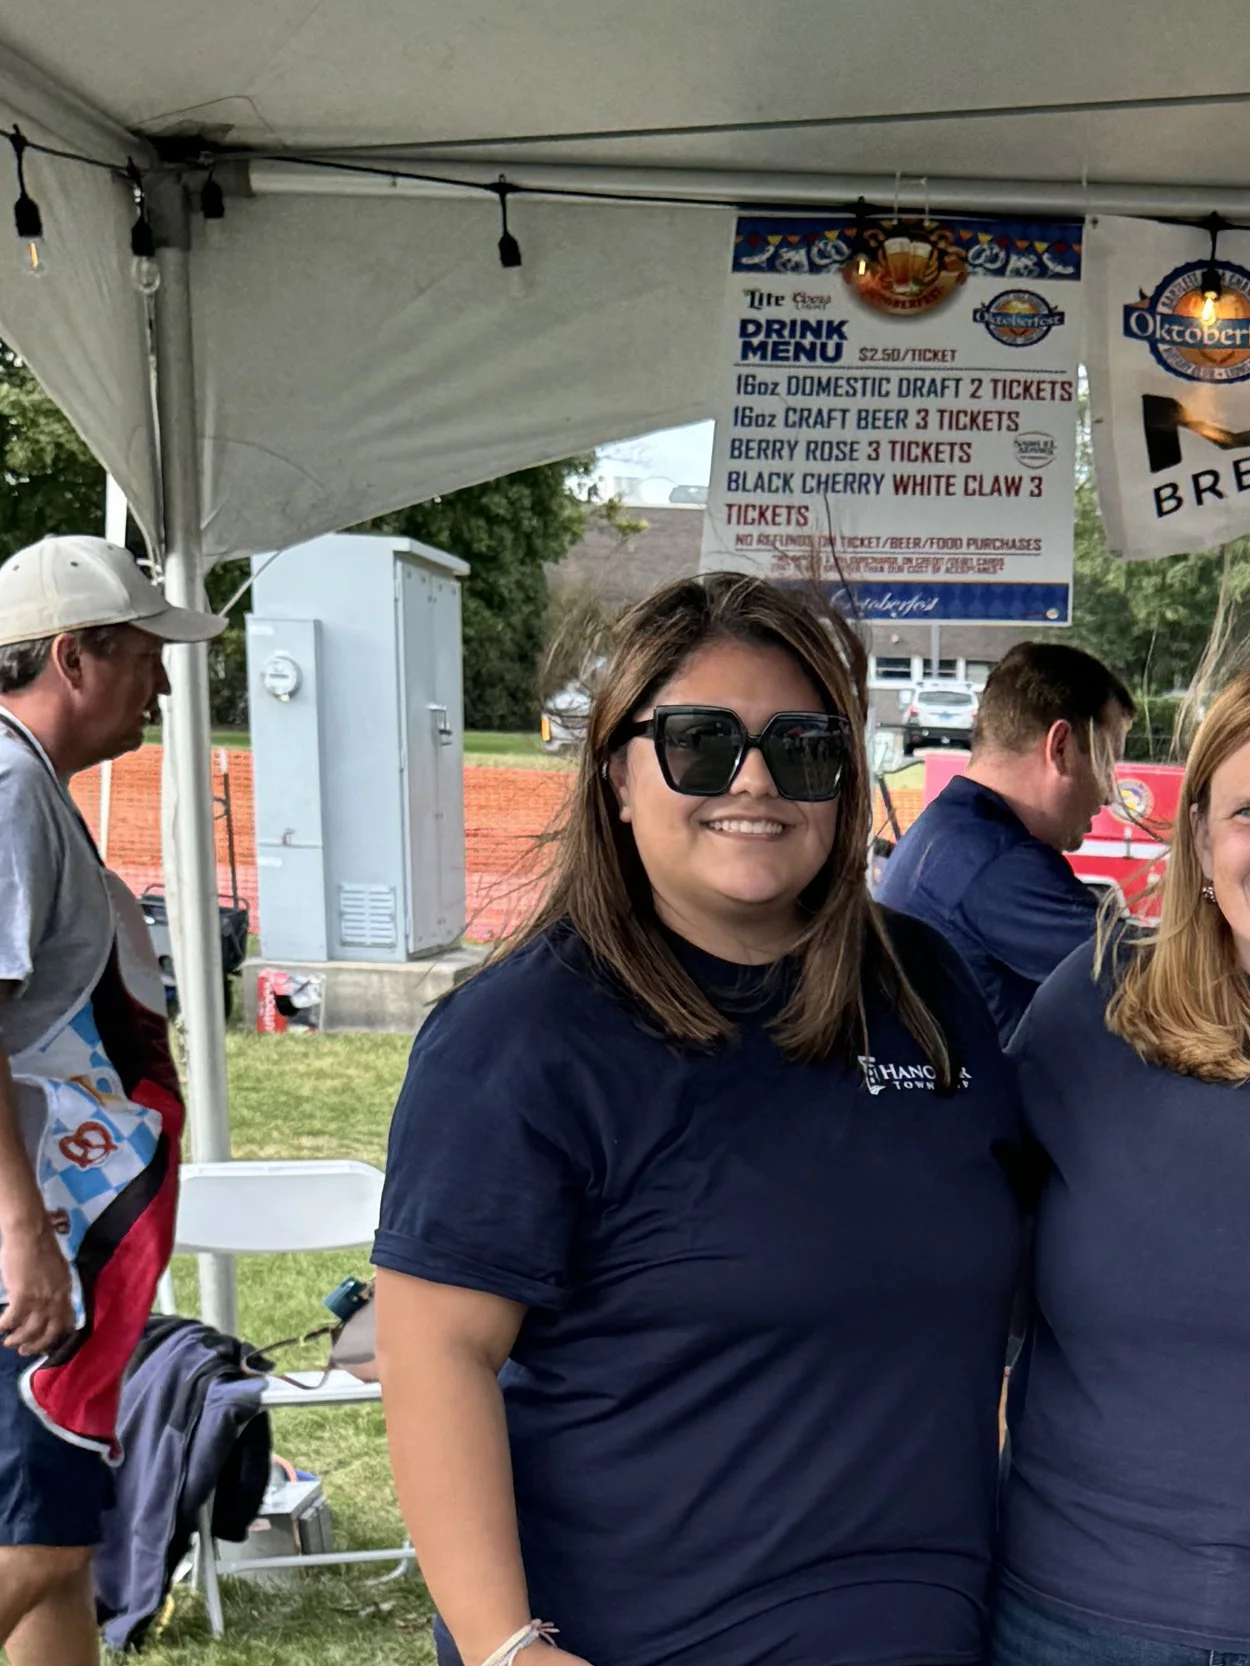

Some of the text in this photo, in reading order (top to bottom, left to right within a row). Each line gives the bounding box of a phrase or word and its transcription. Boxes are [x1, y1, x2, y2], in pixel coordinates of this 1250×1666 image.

[739, 318, 848, 341] DRINK
[740, 341, 957, 363] MENU $2.50/TICKET
[736, 374, 1073, 402] 16oz DOMESTIC DRAFT 2 TICKETS
[733, 406, 1020, 432] 16oz CRAFT BEER 3 TICKETS
[729, 438, 972, 463] BERRY ROSE 3 TICKETS
[727, 471, 1043, 498] BLACK CHERRY WHITE CLAW 3
[725, 503, 809, 527] TICKETS
[967, 538, 1042, 551] PURCHASES
[879, 1063, 972, 1080] HANOR
